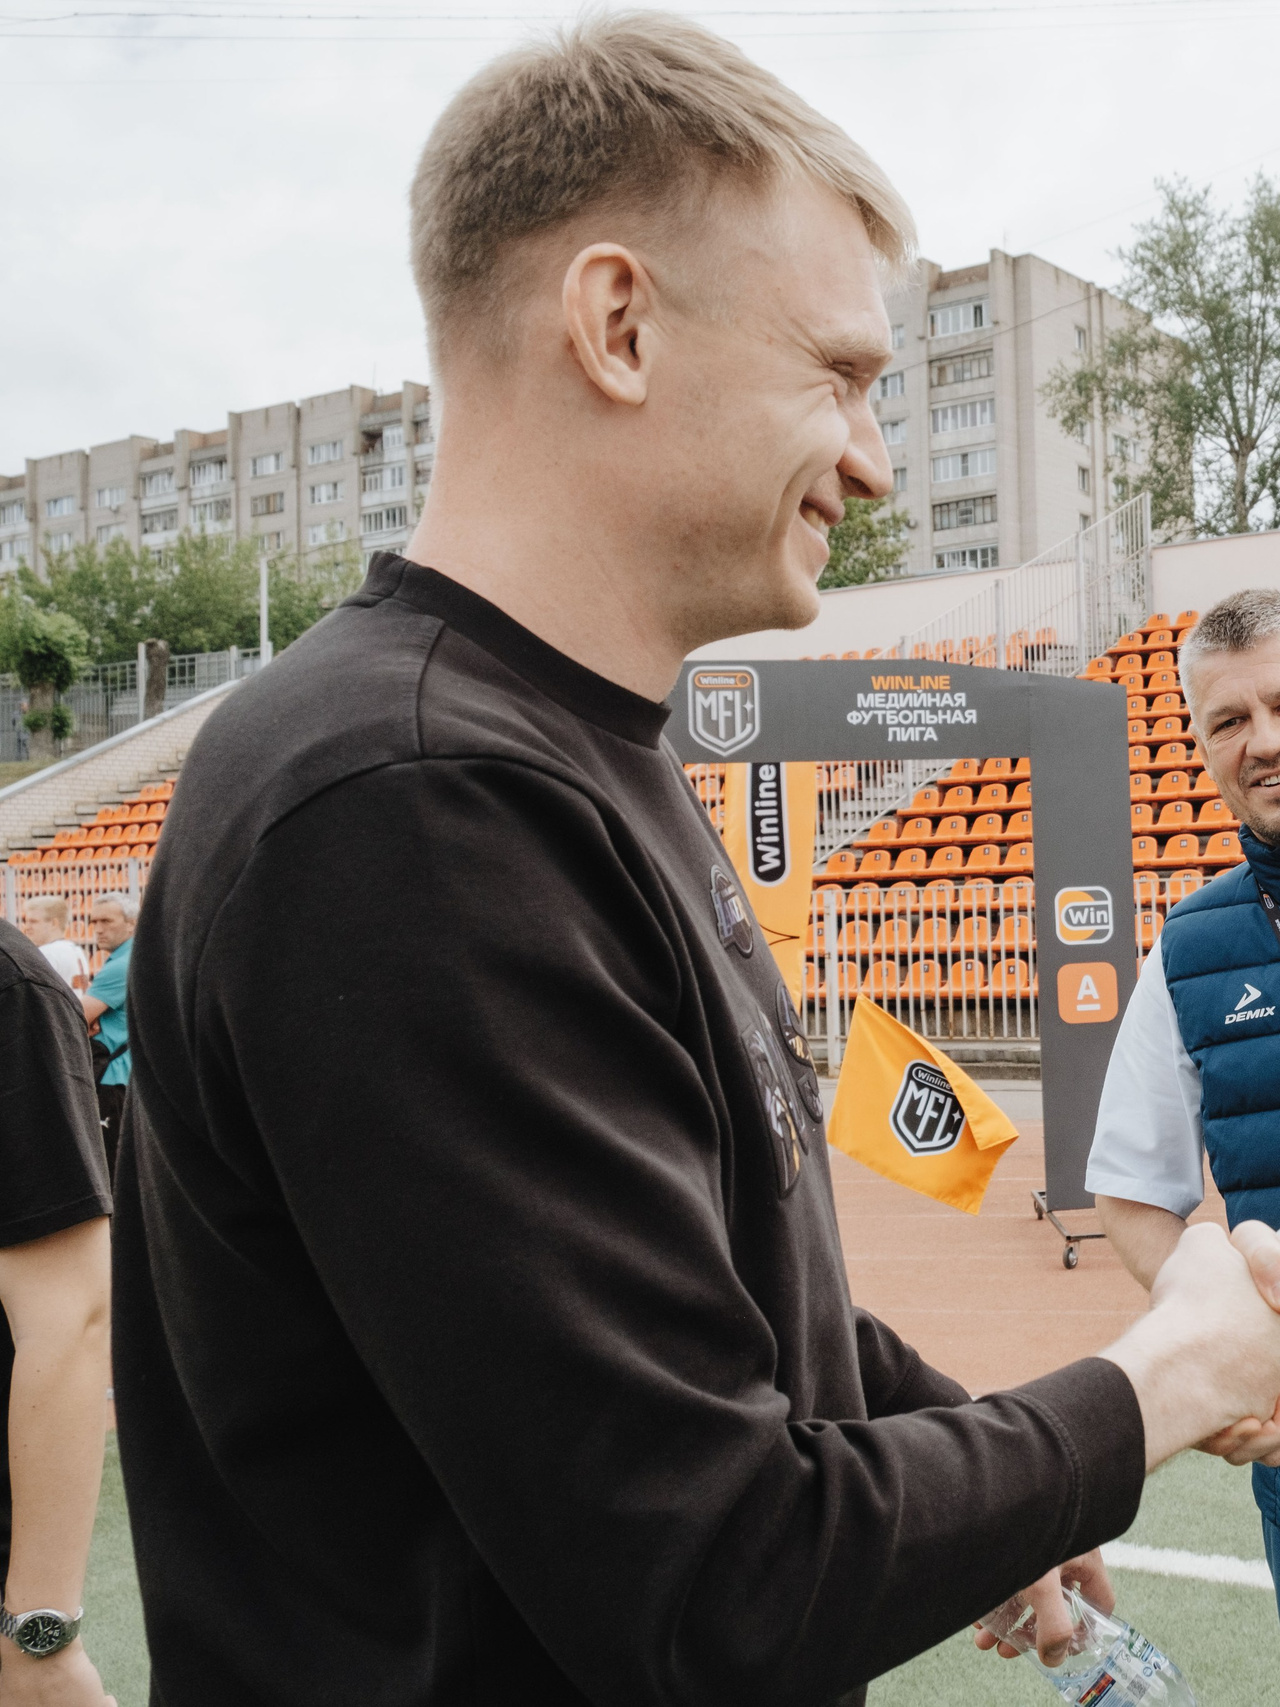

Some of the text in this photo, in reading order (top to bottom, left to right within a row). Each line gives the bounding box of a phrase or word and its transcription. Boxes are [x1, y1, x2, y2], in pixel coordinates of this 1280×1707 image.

[700, 676, 736, 686] Winline
[871, 675, 951, 690] WINLINE
[857, 690, 966, 709] МЕДИЙНАЯ
[696, 690, 753, 746] MFL
[846, 709, 977, 725] ФУТБОЛЬНАЯ
[888, 726, 938, 742] ЛИГА
[755, 763, 780, 872] Winline
[1068, 907, 1108, 925] Win
[1225, 1005, 1275, 1024] DEMIX
[917, 1069, 950, 1090] Winline
[897, 1079, 953, 1146] MFL
